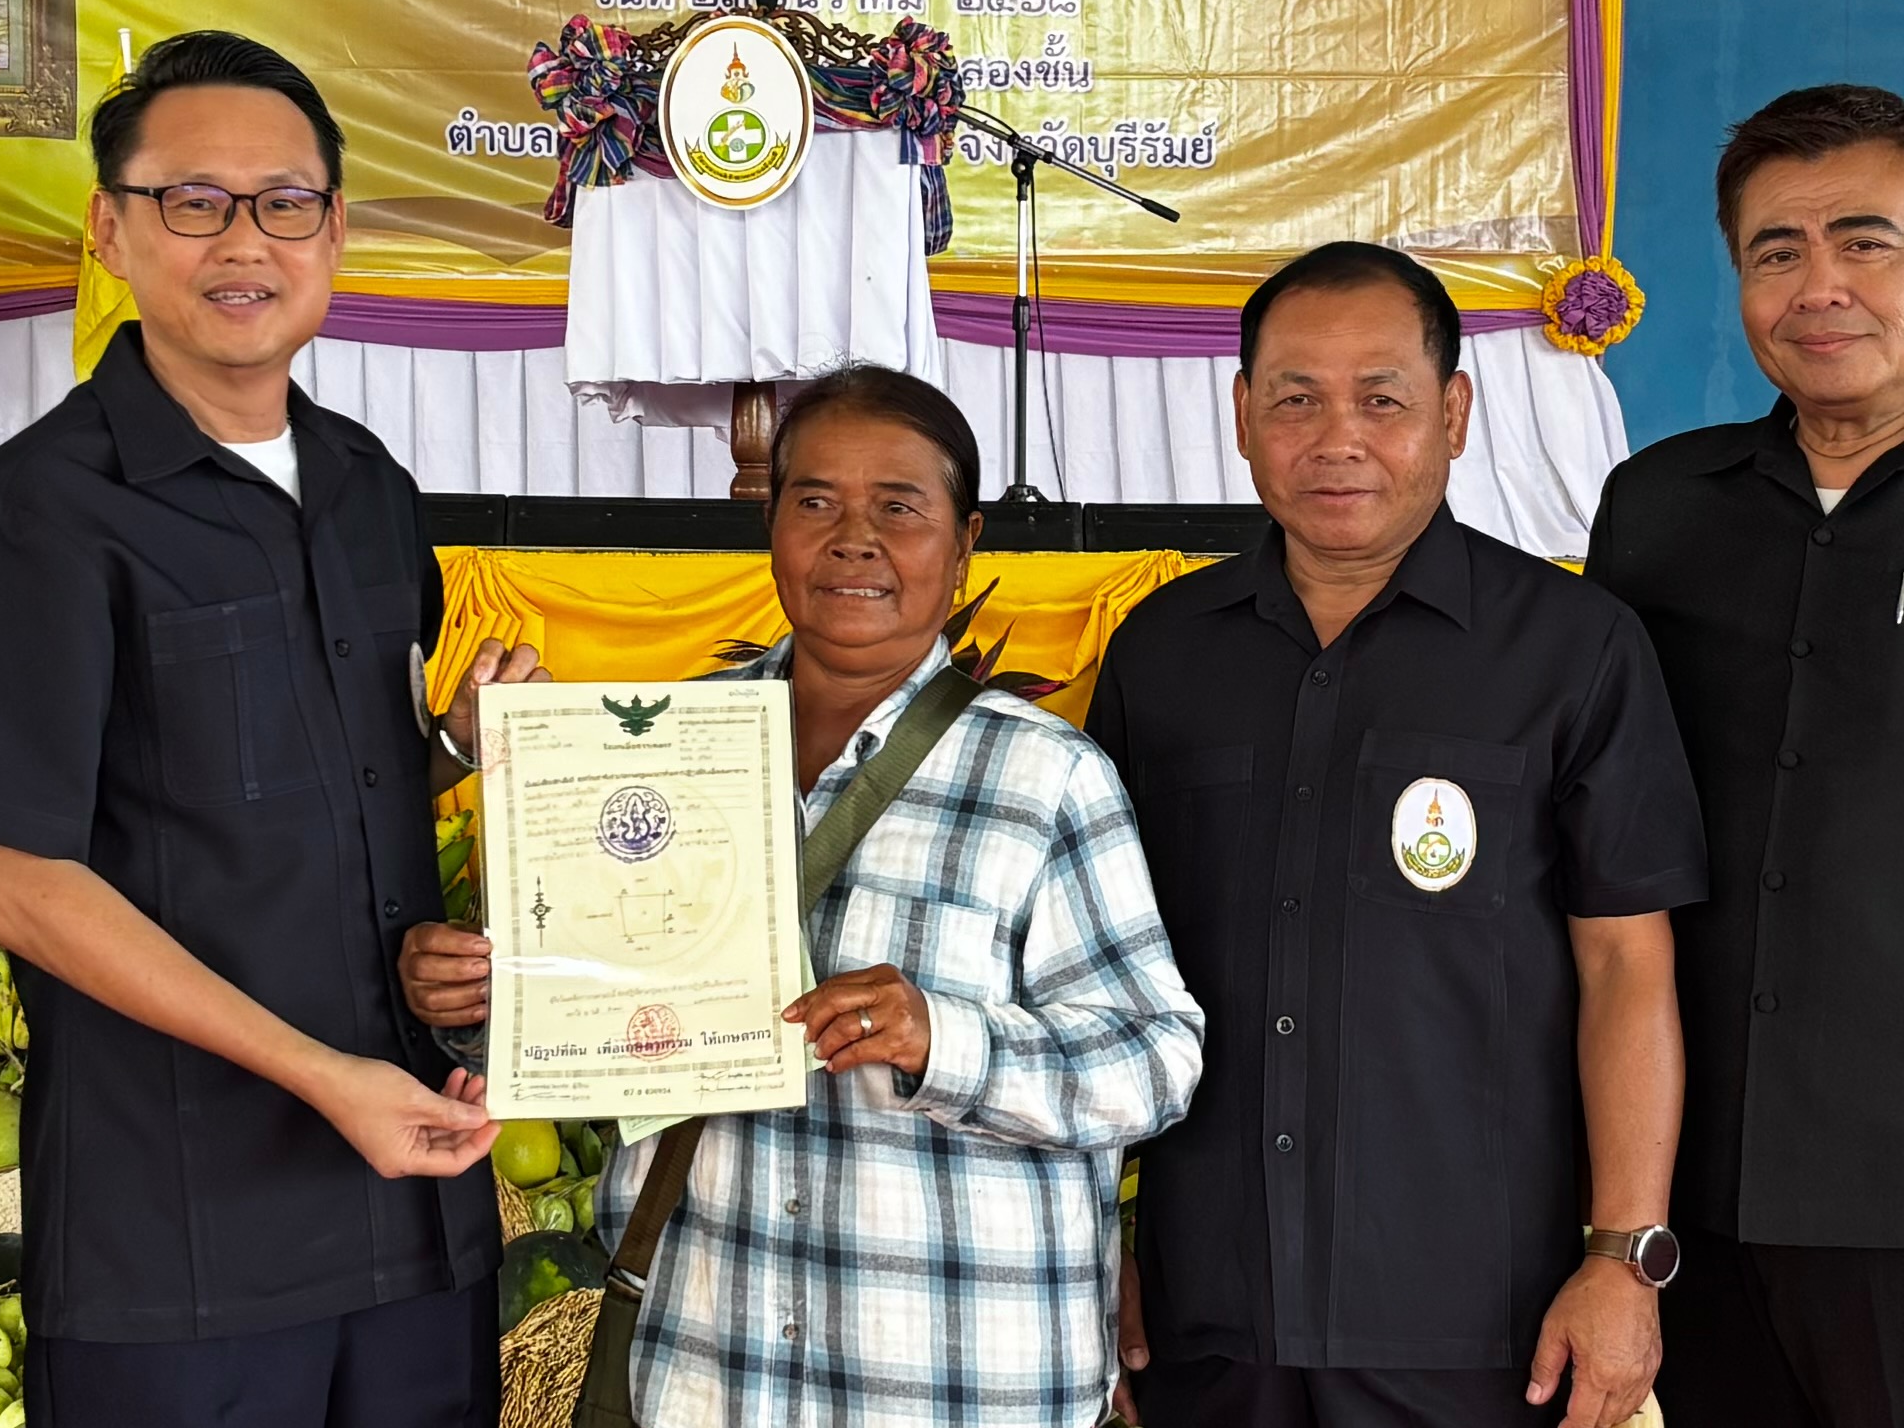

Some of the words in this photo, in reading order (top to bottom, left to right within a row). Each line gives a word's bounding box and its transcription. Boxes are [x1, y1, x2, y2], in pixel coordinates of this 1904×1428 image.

[958, 121, 1215, 177] จังวัดบุรีรัมย์
